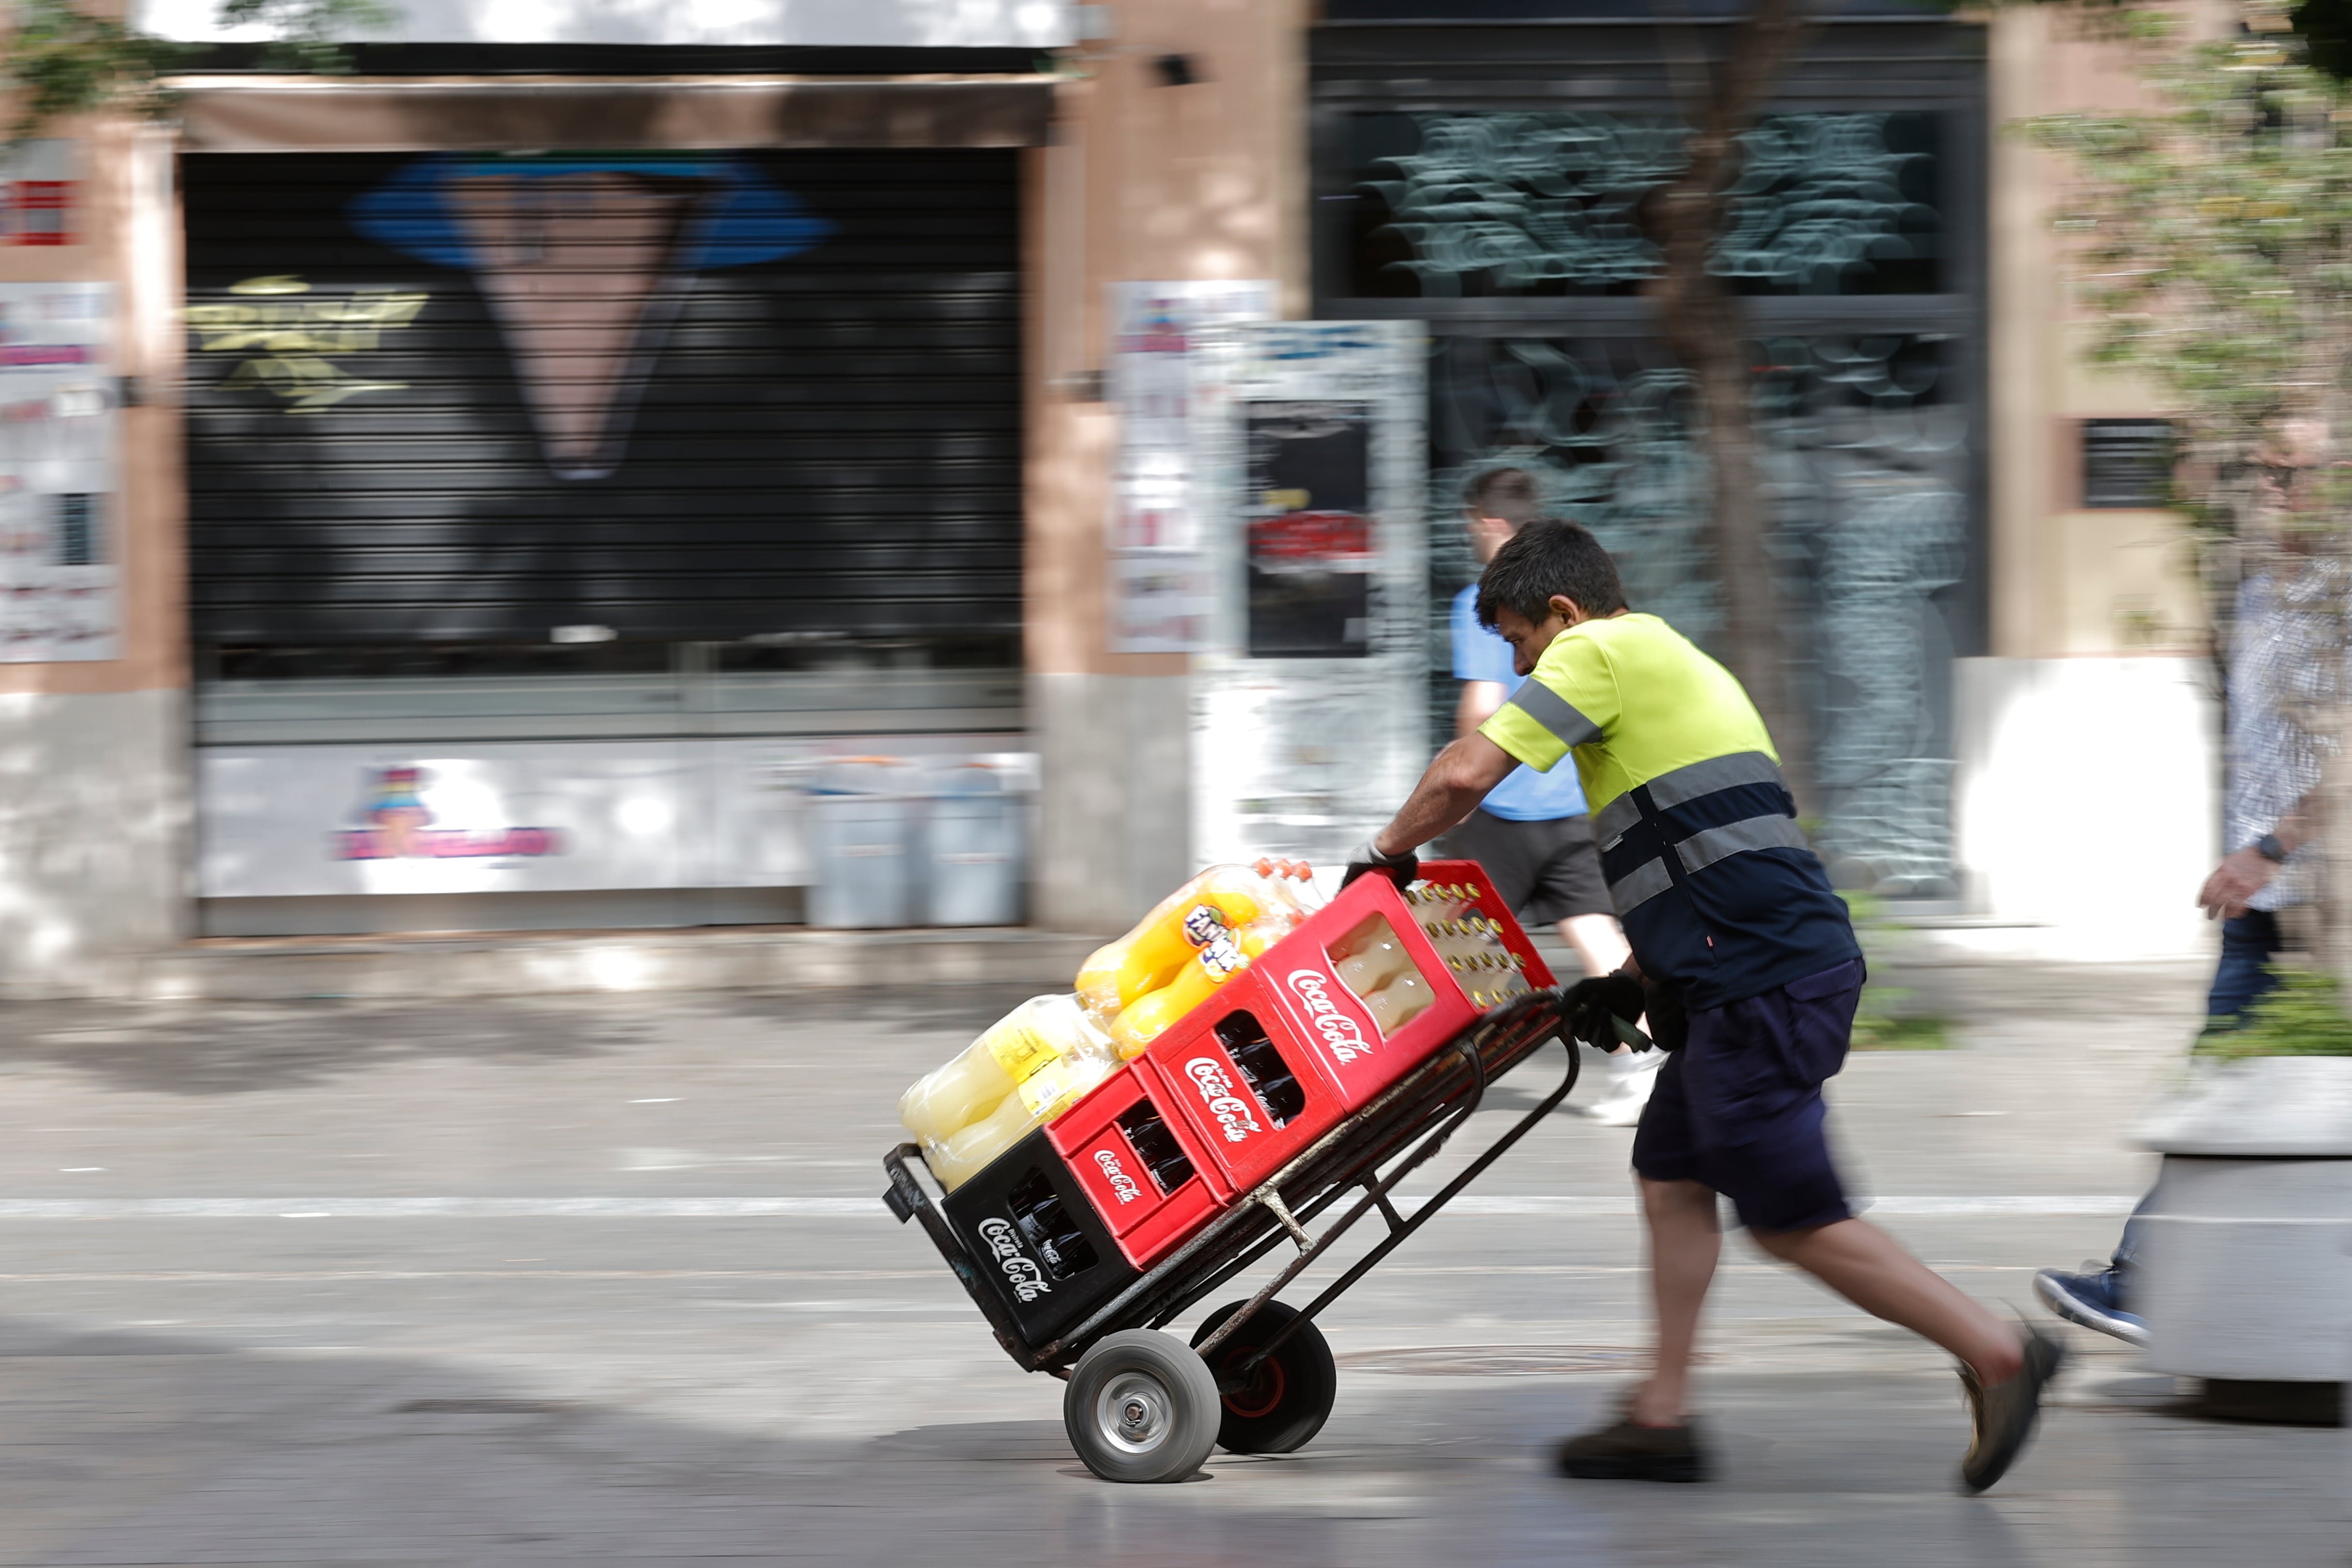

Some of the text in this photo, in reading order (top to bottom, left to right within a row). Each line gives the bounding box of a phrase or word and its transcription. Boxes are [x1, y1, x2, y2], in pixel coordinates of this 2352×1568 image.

[1287, 969, 1374, 1063] Coca-Cola
[1185, 1057, 1262, 1142] Coca-Cola
[1094, 1150, 1142, 1202] Coca-Cola
[978, 1217, 1052, 1301] Coca-Cola
[1008, 1229, 1024, 1249] Disfruta
